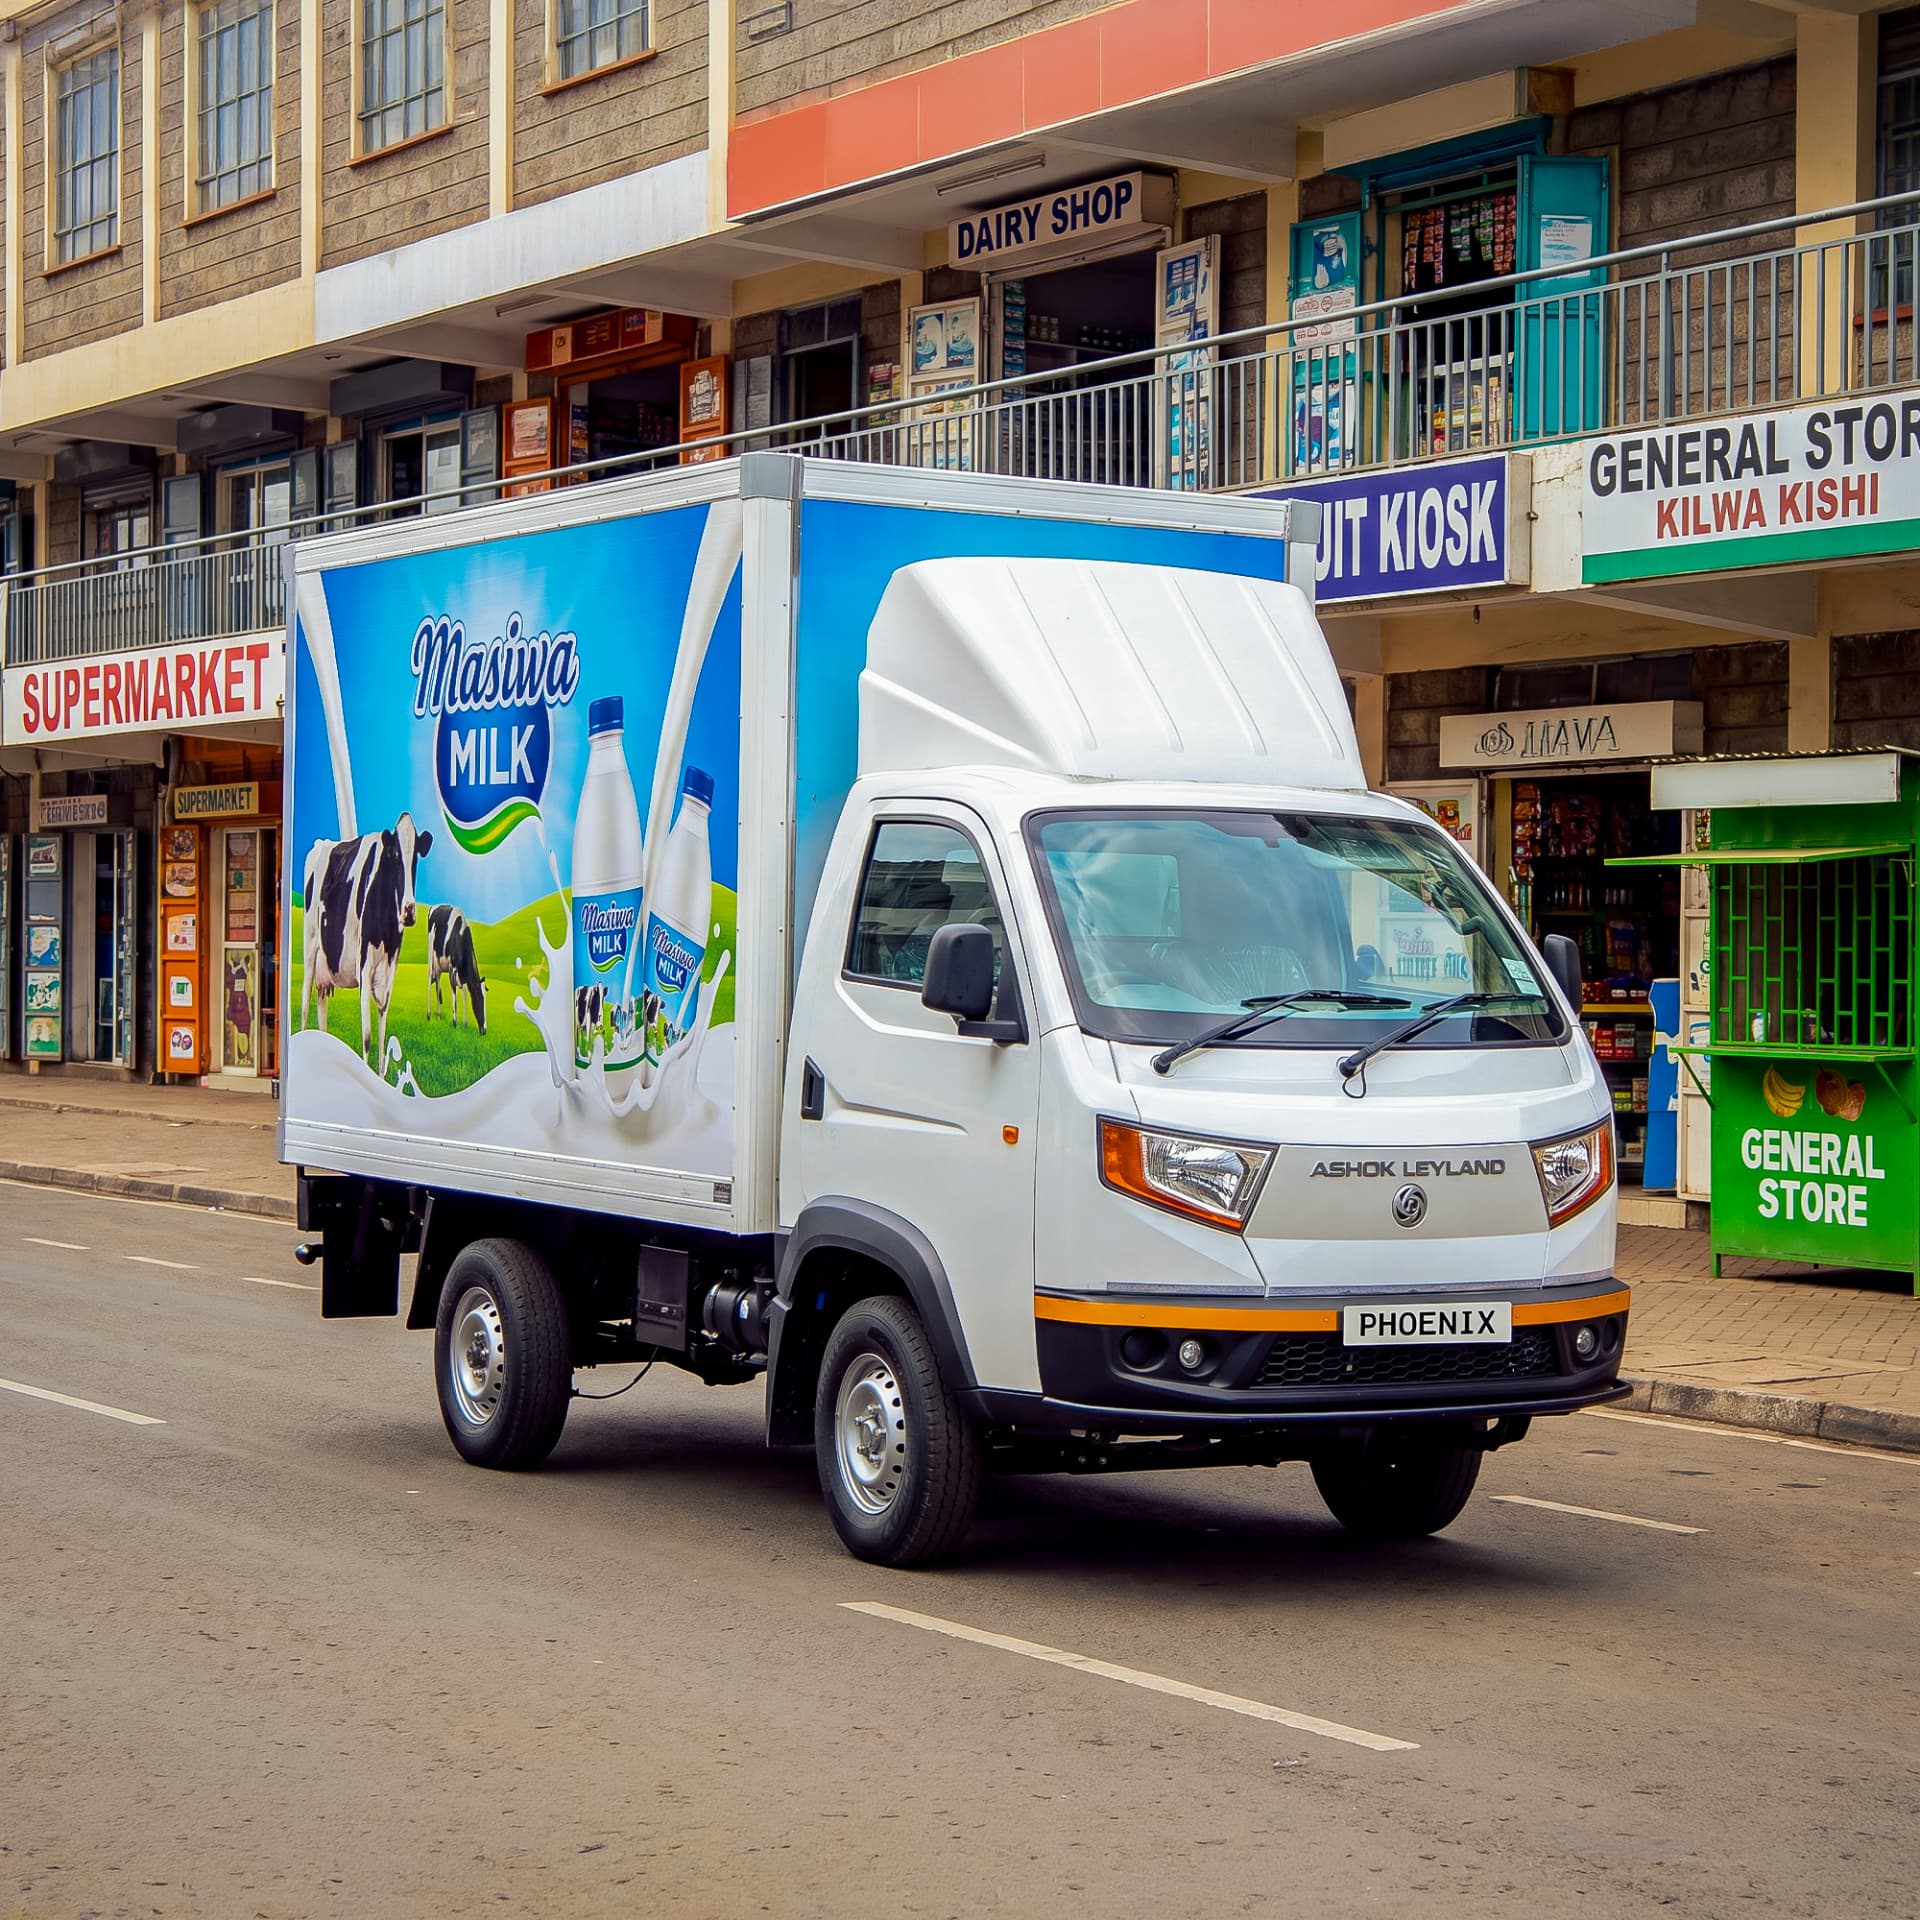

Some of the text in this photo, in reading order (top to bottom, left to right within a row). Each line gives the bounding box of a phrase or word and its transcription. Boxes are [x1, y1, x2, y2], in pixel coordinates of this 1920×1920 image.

[958, 180, 1133, 259] DAIRY SHOP
[1590, 420, 1790, 497] GENERAL
[1379, 480, 1497, 574] KIOSK
[1656, 472, 1879, 540] KILWA KISHI
[23, 643, 270, 735] SUPERMARKET
[411, 610, 580, 718] Masiwa
[450, 724, 536, 787] MILK
[178, 787, 253, 815] SUPERMARKET
[582, 900, 634, 933] Masiwa
[592, 933, 623, 954] MILK
[658, 960, 684, 985] MILK
[1310, 1159, 1506, 1178] ASHOK LEYLAND
[1741, 1128, 1885, 1179] GENERAL
[1758, 1178, 1868, 1227] STORE
[1360, 1310, 1496, 1337] PHOENIX
